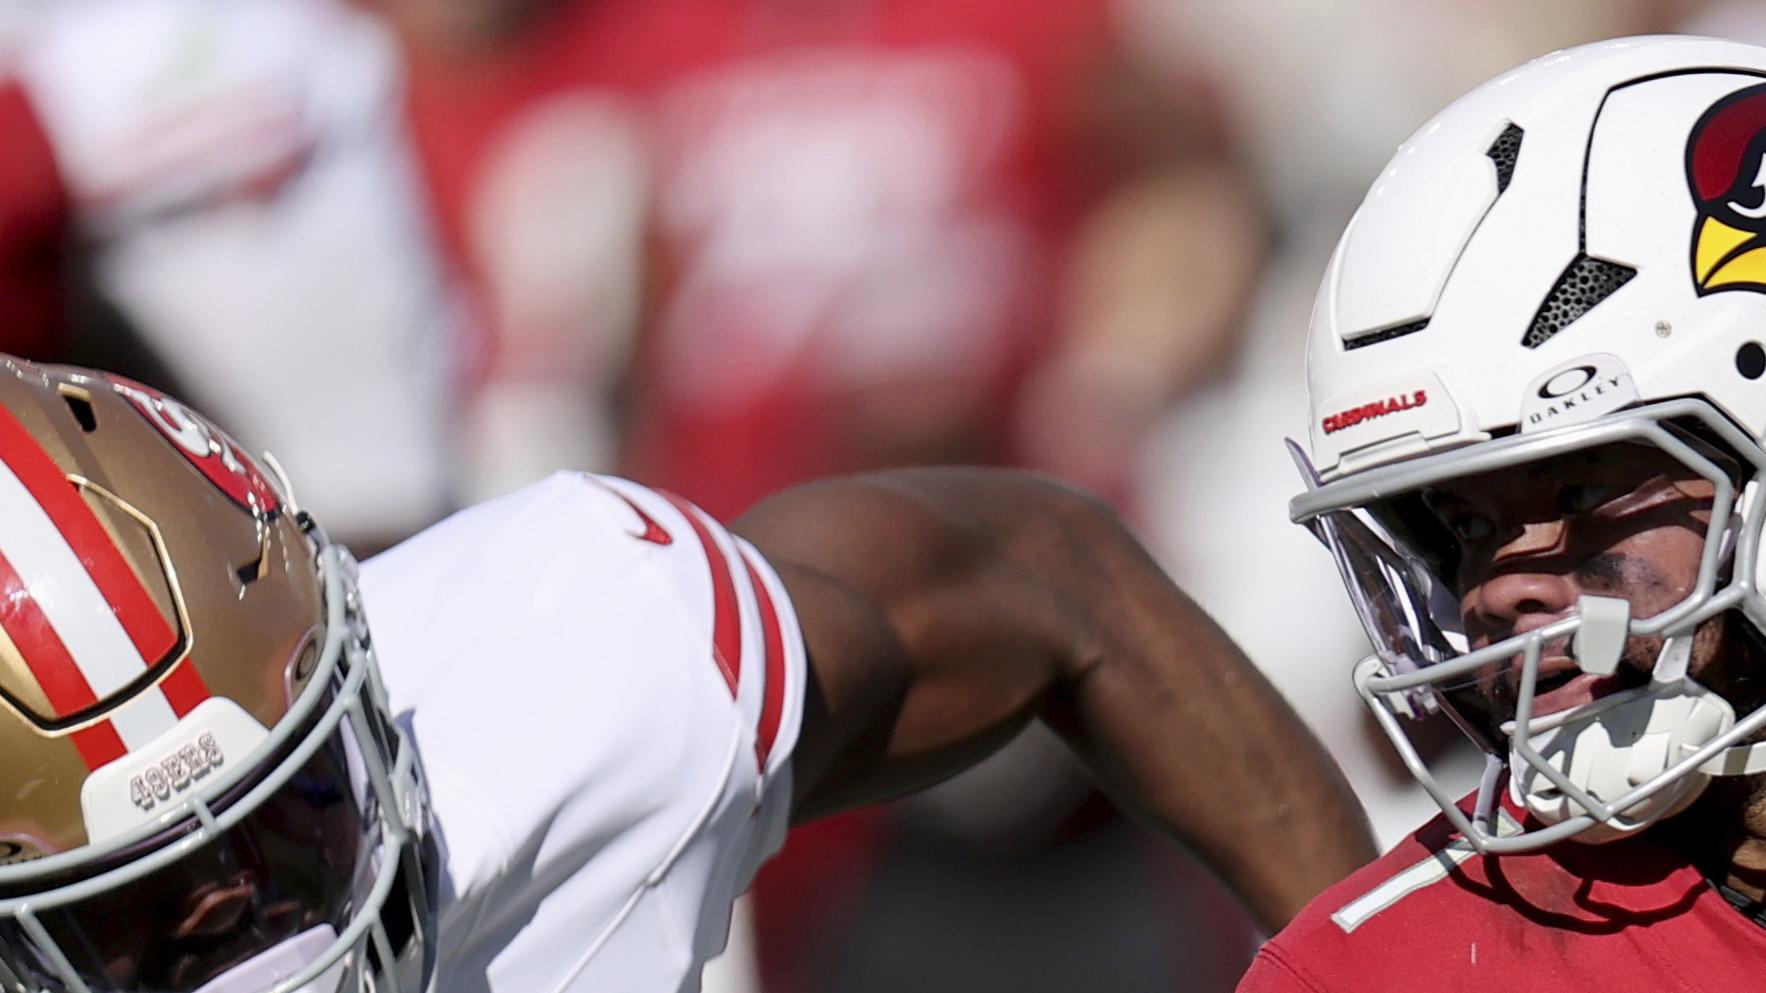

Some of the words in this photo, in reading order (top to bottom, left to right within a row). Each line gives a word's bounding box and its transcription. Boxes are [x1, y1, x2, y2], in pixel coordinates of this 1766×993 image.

[1322, 389, 1427, 435] CARDINALS
[1528, 375, 1620, 425] OAKLEY
[129, 731, 225, 811] 49ERS
